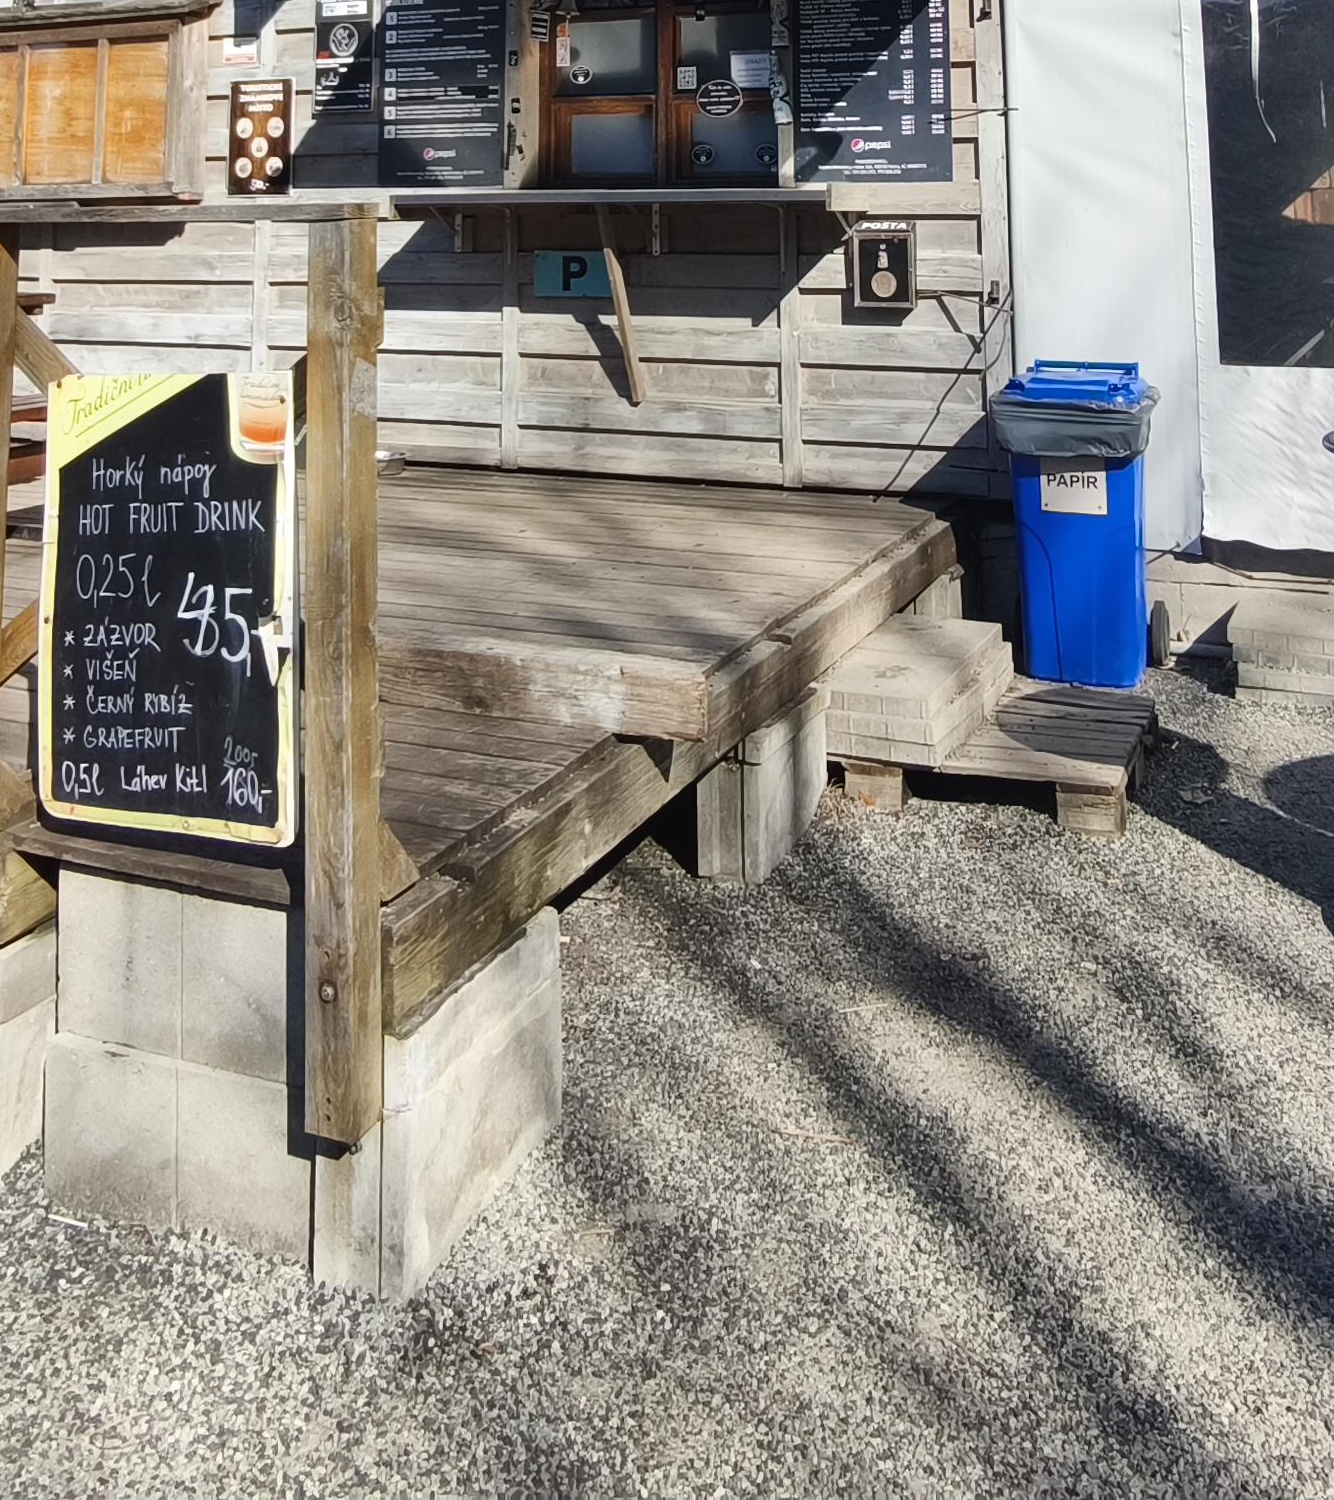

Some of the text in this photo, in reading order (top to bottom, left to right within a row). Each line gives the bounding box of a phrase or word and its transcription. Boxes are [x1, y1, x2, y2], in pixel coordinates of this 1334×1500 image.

[562, 256, 588, 292] P
[92, 451, 217, 500] Horký nápoj
[1046, 471, 1099, 489] PAPÍR
[79, 498, 266, 536] HOT FRUIT DRINK
[83, 615, 162, 652] ZÁZVOR
[85, 648, 140, 682] VIŠEŇ
[86, 685, 194, 716] ČERNÝ RYBÍZ
[83, 725, 186, 753] GRAPEFRUIT
[120, 764, 167, 793] Láhev
[175, 764, 207, 794] Kitl
